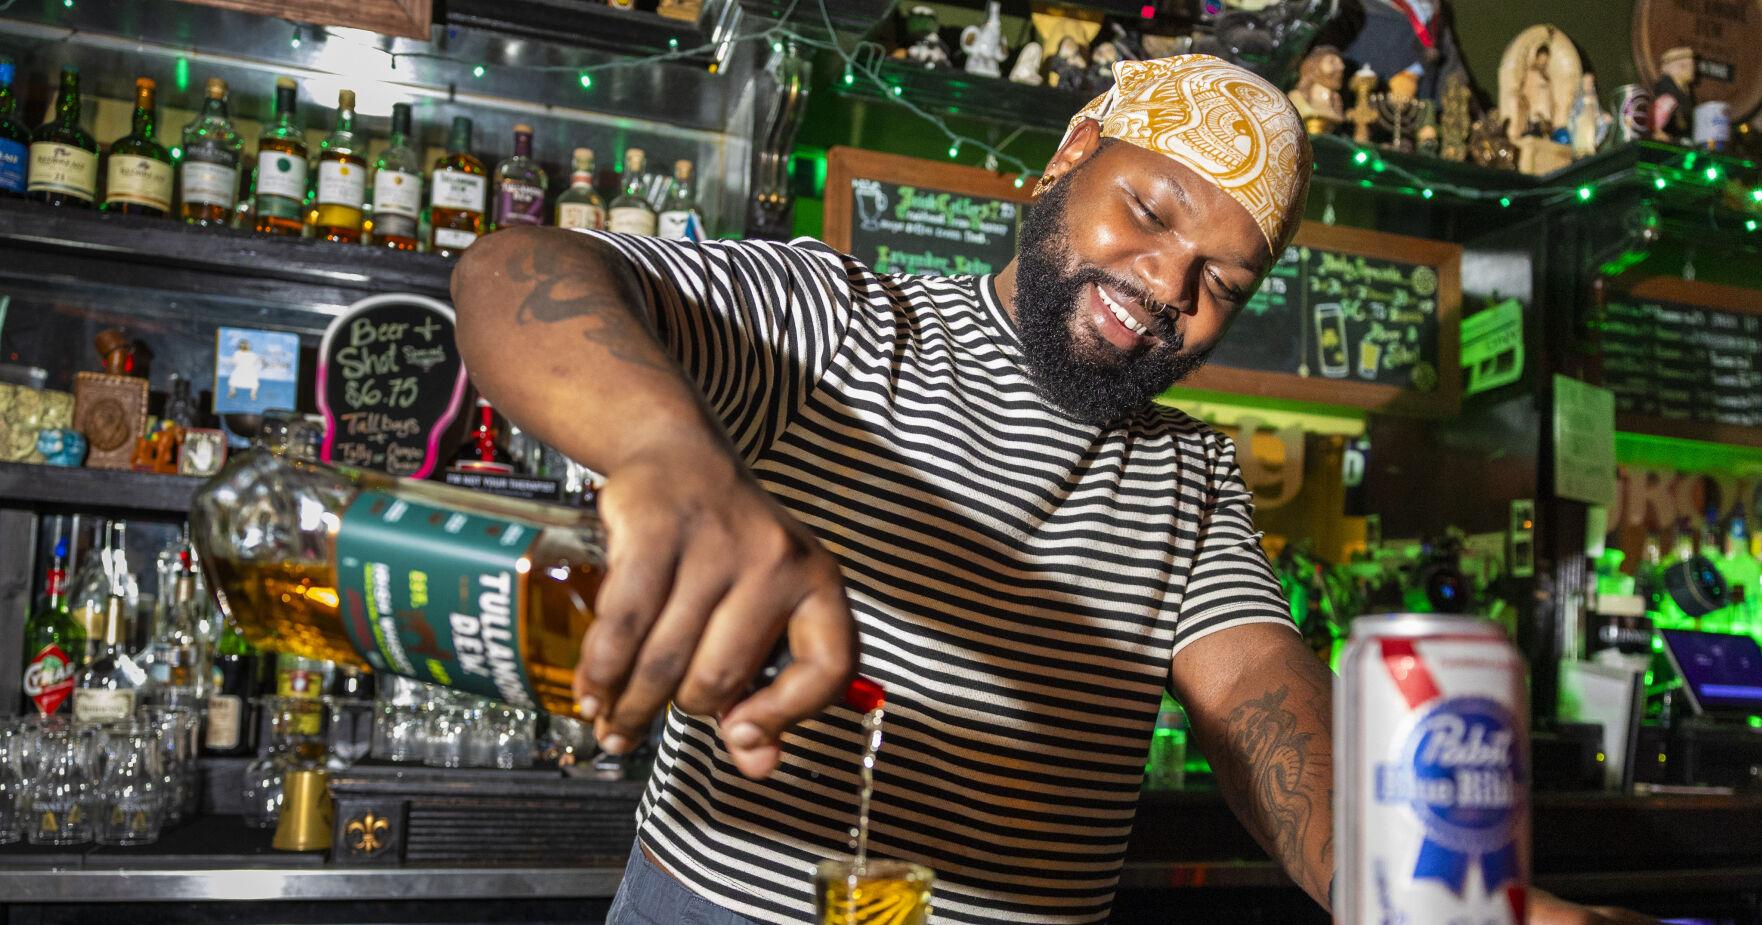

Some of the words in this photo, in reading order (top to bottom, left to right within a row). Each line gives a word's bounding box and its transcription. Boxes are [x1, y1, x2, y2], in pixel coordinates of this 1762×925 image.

[351, 317, 410, 347] Beer
[413, 315, 442, 342] +
[335, 343, 400, 380] Shot
[344, 376, 419, 410] $6.75
[1420, 714, 1512, 769] Pabst
